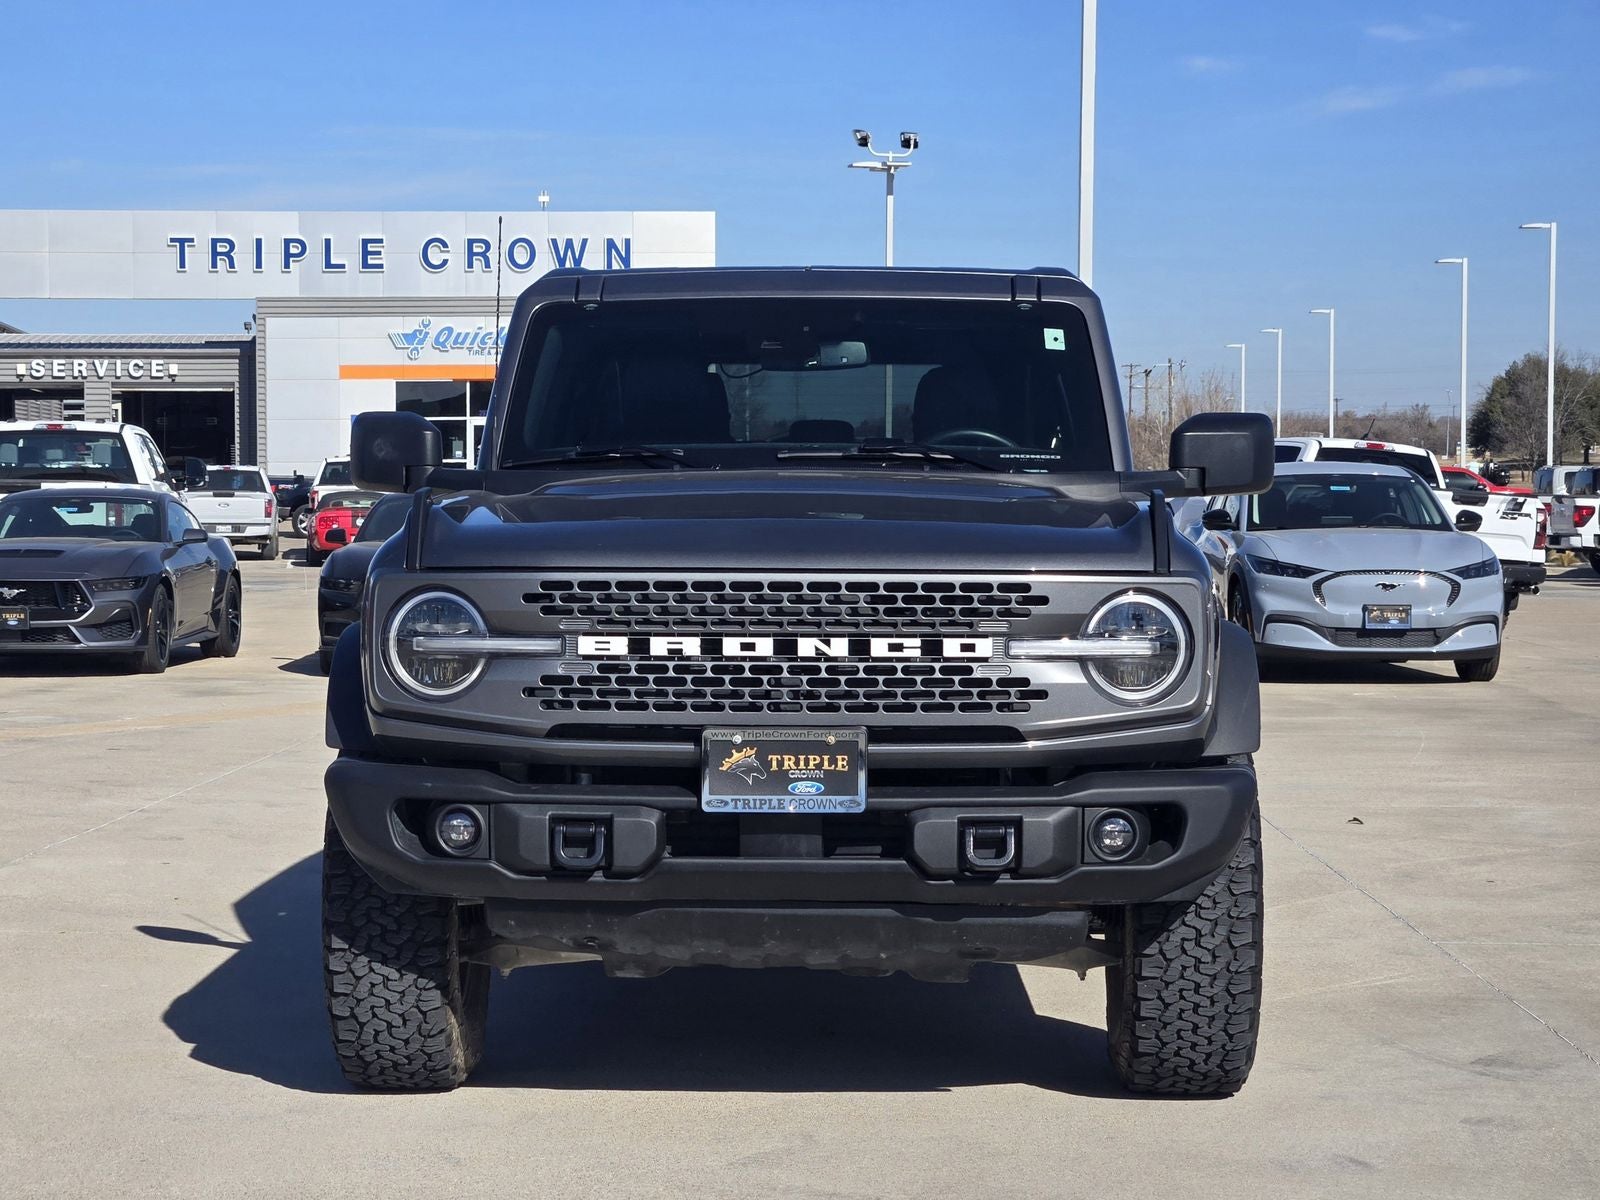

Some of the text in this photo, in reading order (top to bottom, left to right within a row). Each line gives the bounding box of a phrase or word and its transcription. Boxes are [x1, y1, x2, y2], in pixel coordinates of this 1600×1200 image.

[168, 236, 632, 272] TRIPLE CROWN
[30, 359, 165, 379] SERVICE
[577, 635, 994, 657] BRONCO
[710, 730, 859, 740] wwwTripleCrownFordcom
[768, 755, 849, 771] TRIPLE
[788, 770, 824, 778] CROWN
[794, 783, 817, 793] Ford
[730, 798, 786, 810] TRIPLE
[788, 798, 837, 810] CROWN
